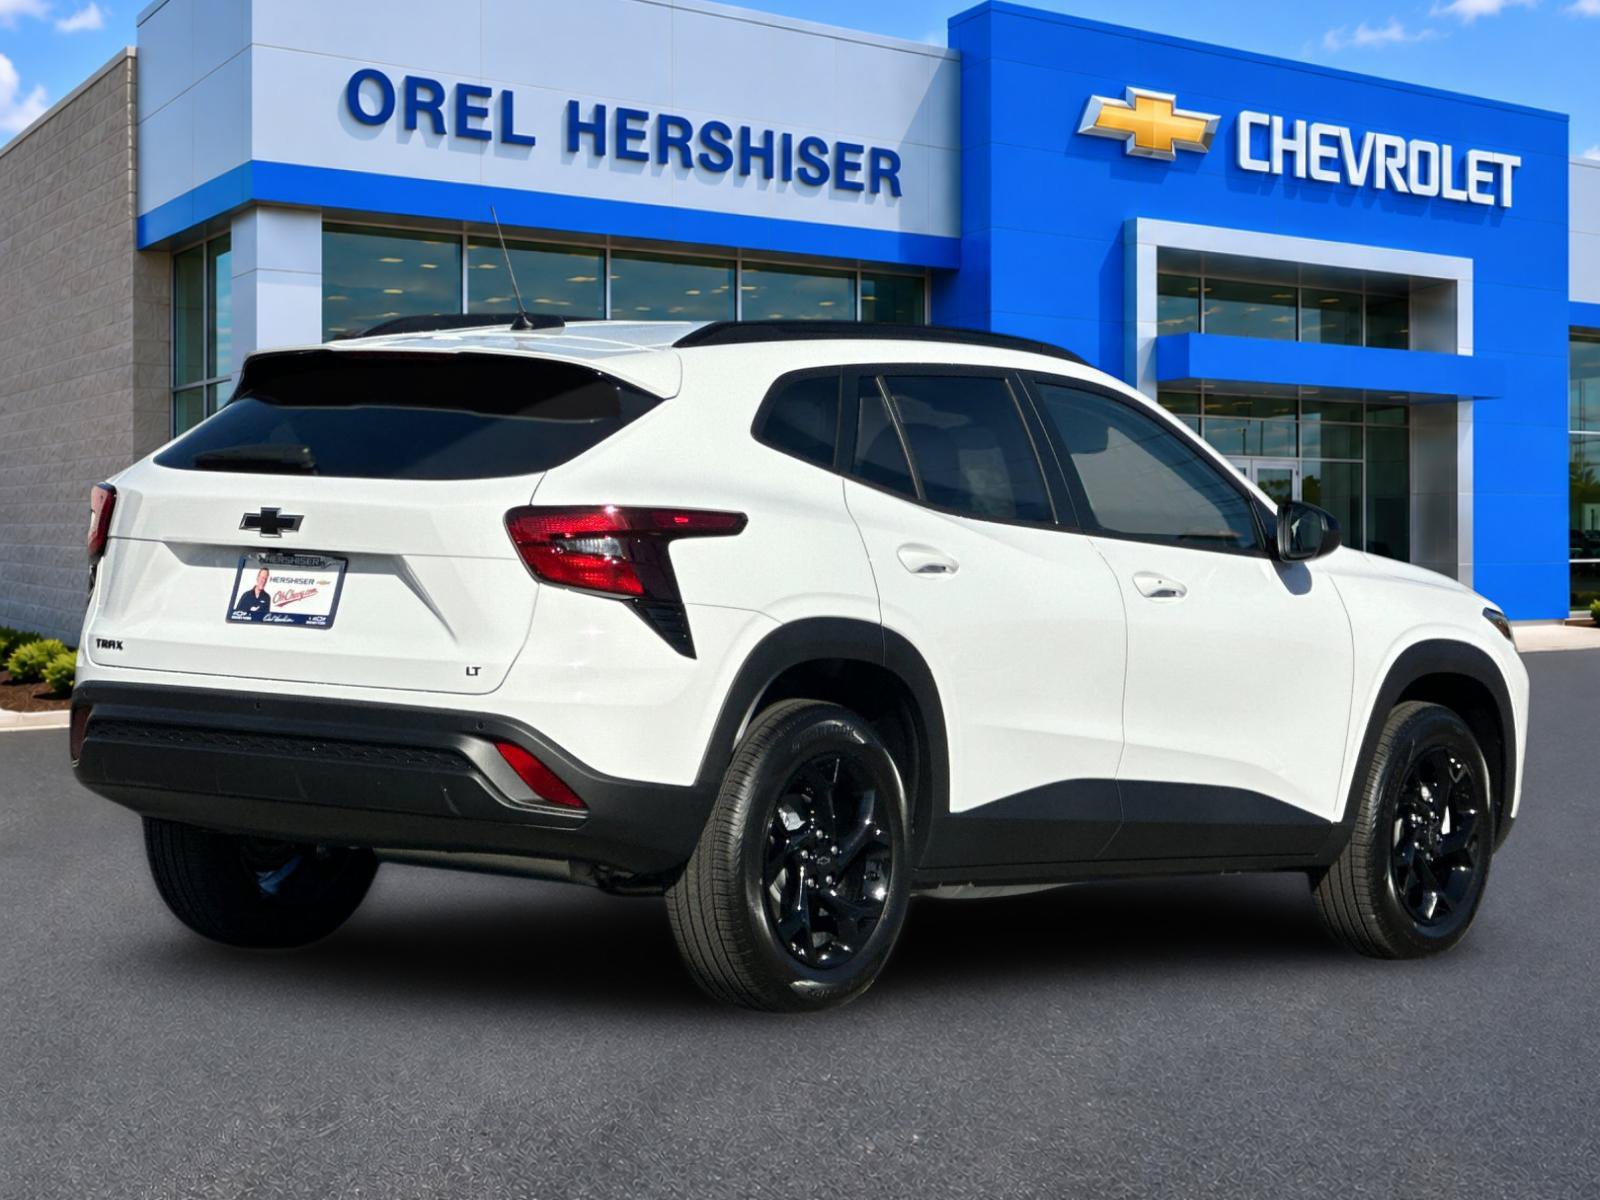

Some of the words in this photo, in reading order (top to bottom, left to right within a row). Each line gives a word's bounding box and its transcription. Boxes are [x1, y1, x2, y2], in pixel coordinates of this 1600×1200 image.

[346, 68, 536, 147] OREL
[567, 99, 903, 198] HERSHISER
[1238, 110, 1522, 208] CHEVROLET
[269, 576, 315, 586] HERSHISER
[96, 638, 123, 651] TRAX
[466, 666, 482, 676] LT
